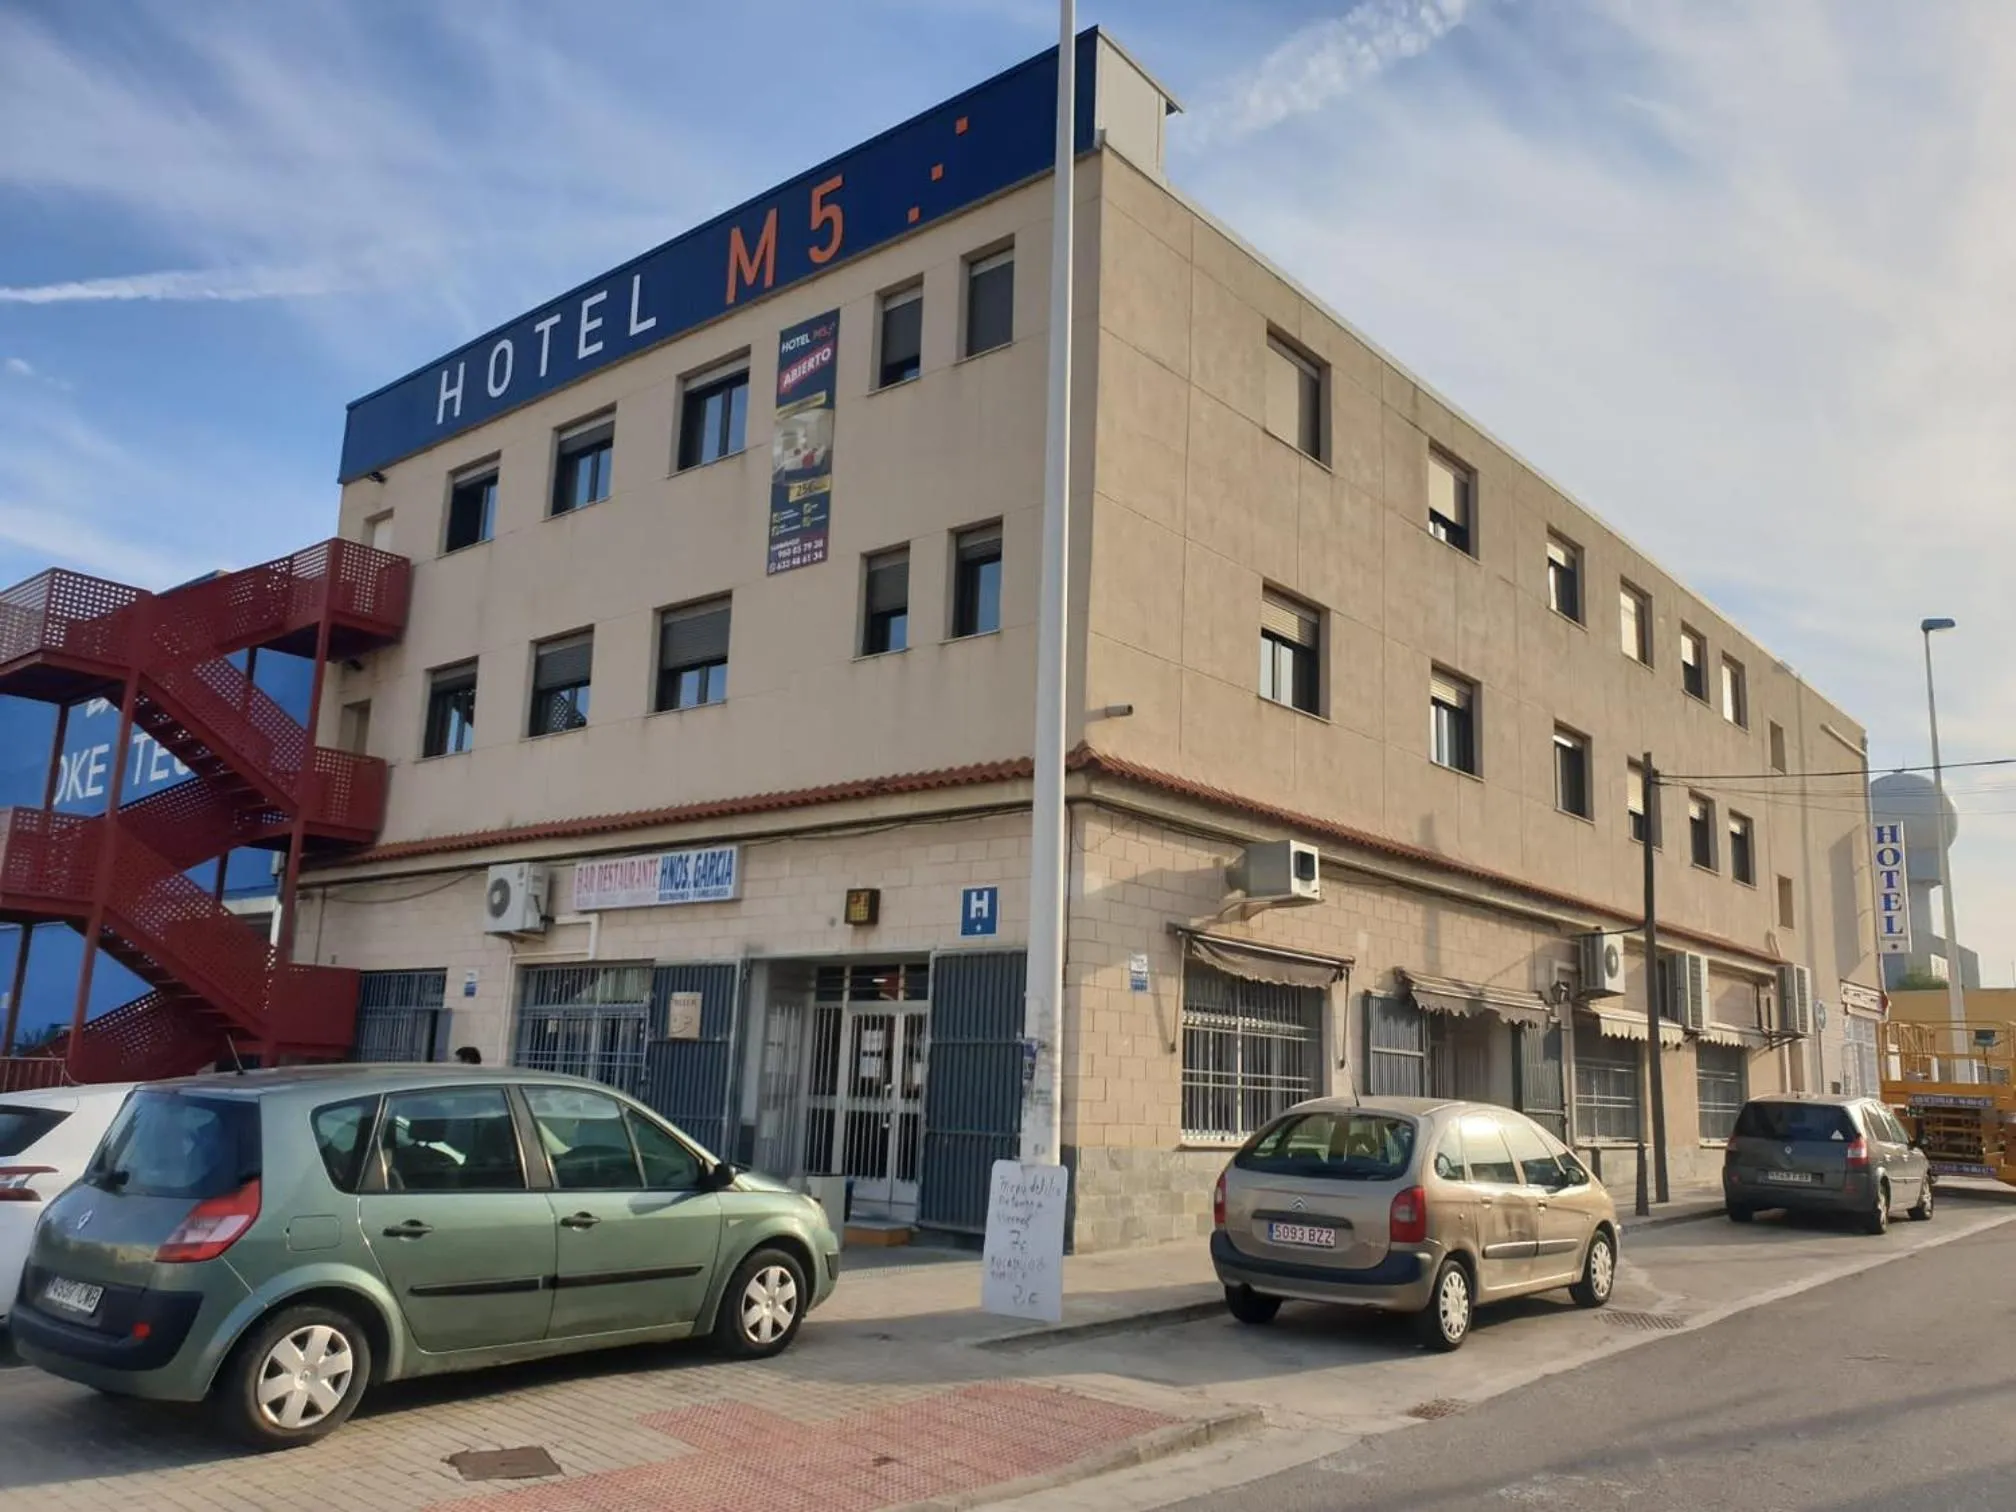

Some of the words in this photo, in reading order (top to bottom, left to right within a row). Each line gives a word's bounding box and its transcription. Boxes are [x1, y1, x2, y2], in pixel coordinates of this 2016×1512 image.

[436, 274, 657, 425] HOTEL
[725, 173, 844, 305] M5
[781, 333, 811, 353] HOTEL
[783, 347, 832, 388] ABIERTO
[1875, 824, 1903, 935] HOTEL
[970, 891, 989, 919] H
[1275, 1225, 1305, 1241] 5093
[1308, 1228, 1333, 1244] BZZ
